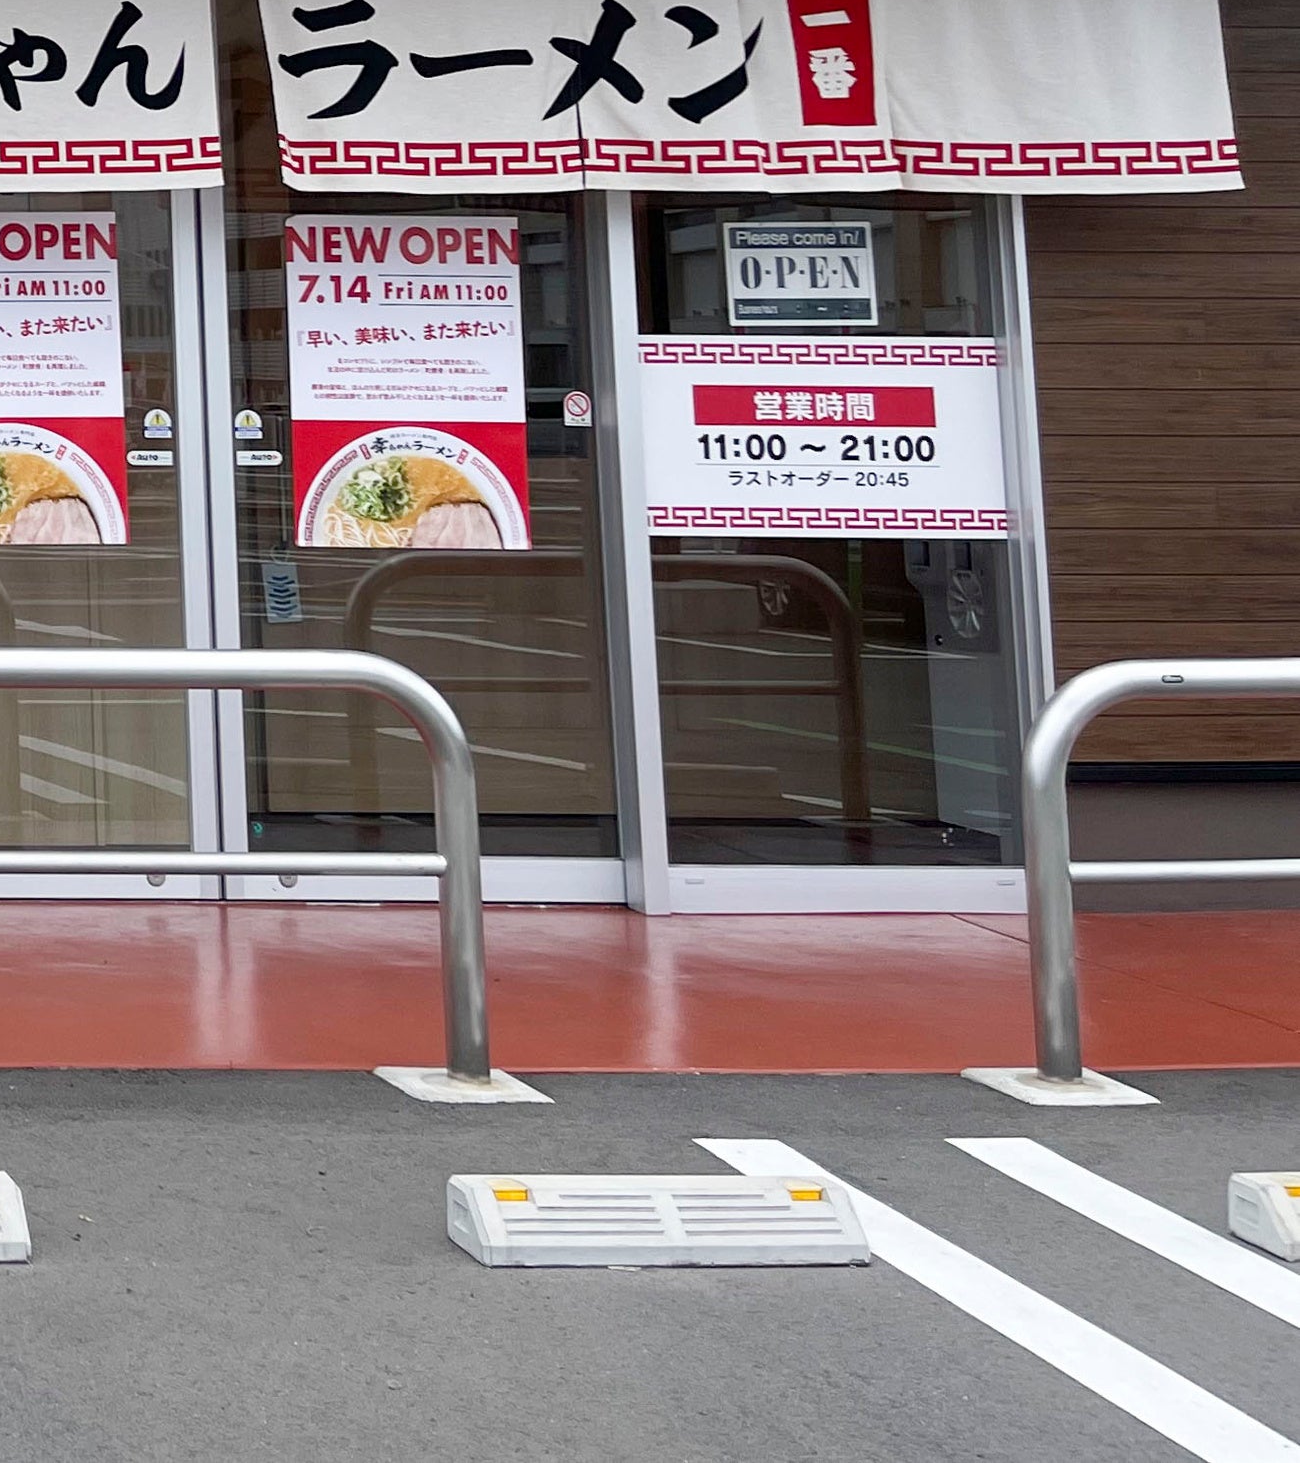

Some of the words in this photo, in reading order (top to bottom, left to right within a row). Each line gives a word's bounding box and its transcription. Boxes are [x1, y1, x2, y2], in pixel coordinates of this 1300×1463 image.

[286, 226, 391, 263] NEW
[399, 228, 519, 265] OPEN
[735, 231, 788, 245] Please
[793, 233, 836, 245] come
[17, 279, 46, 296] AM
[53, 280, 106, 296] 11:00
[298, 275, 371, 303] 7.14
[384, 281, 413, 300] Fri
[420, 283, 449, 300] AM
[456, 284, 508, 301] 11:00
[754, 392, 876, 422] 営業時間
[697, 434, 786, 461] 11:00
[840, 435, 935, 462] 21:00
[728, 470, 849, 487] ラストオーダー
[855, 472, 909, 487] 20:45
